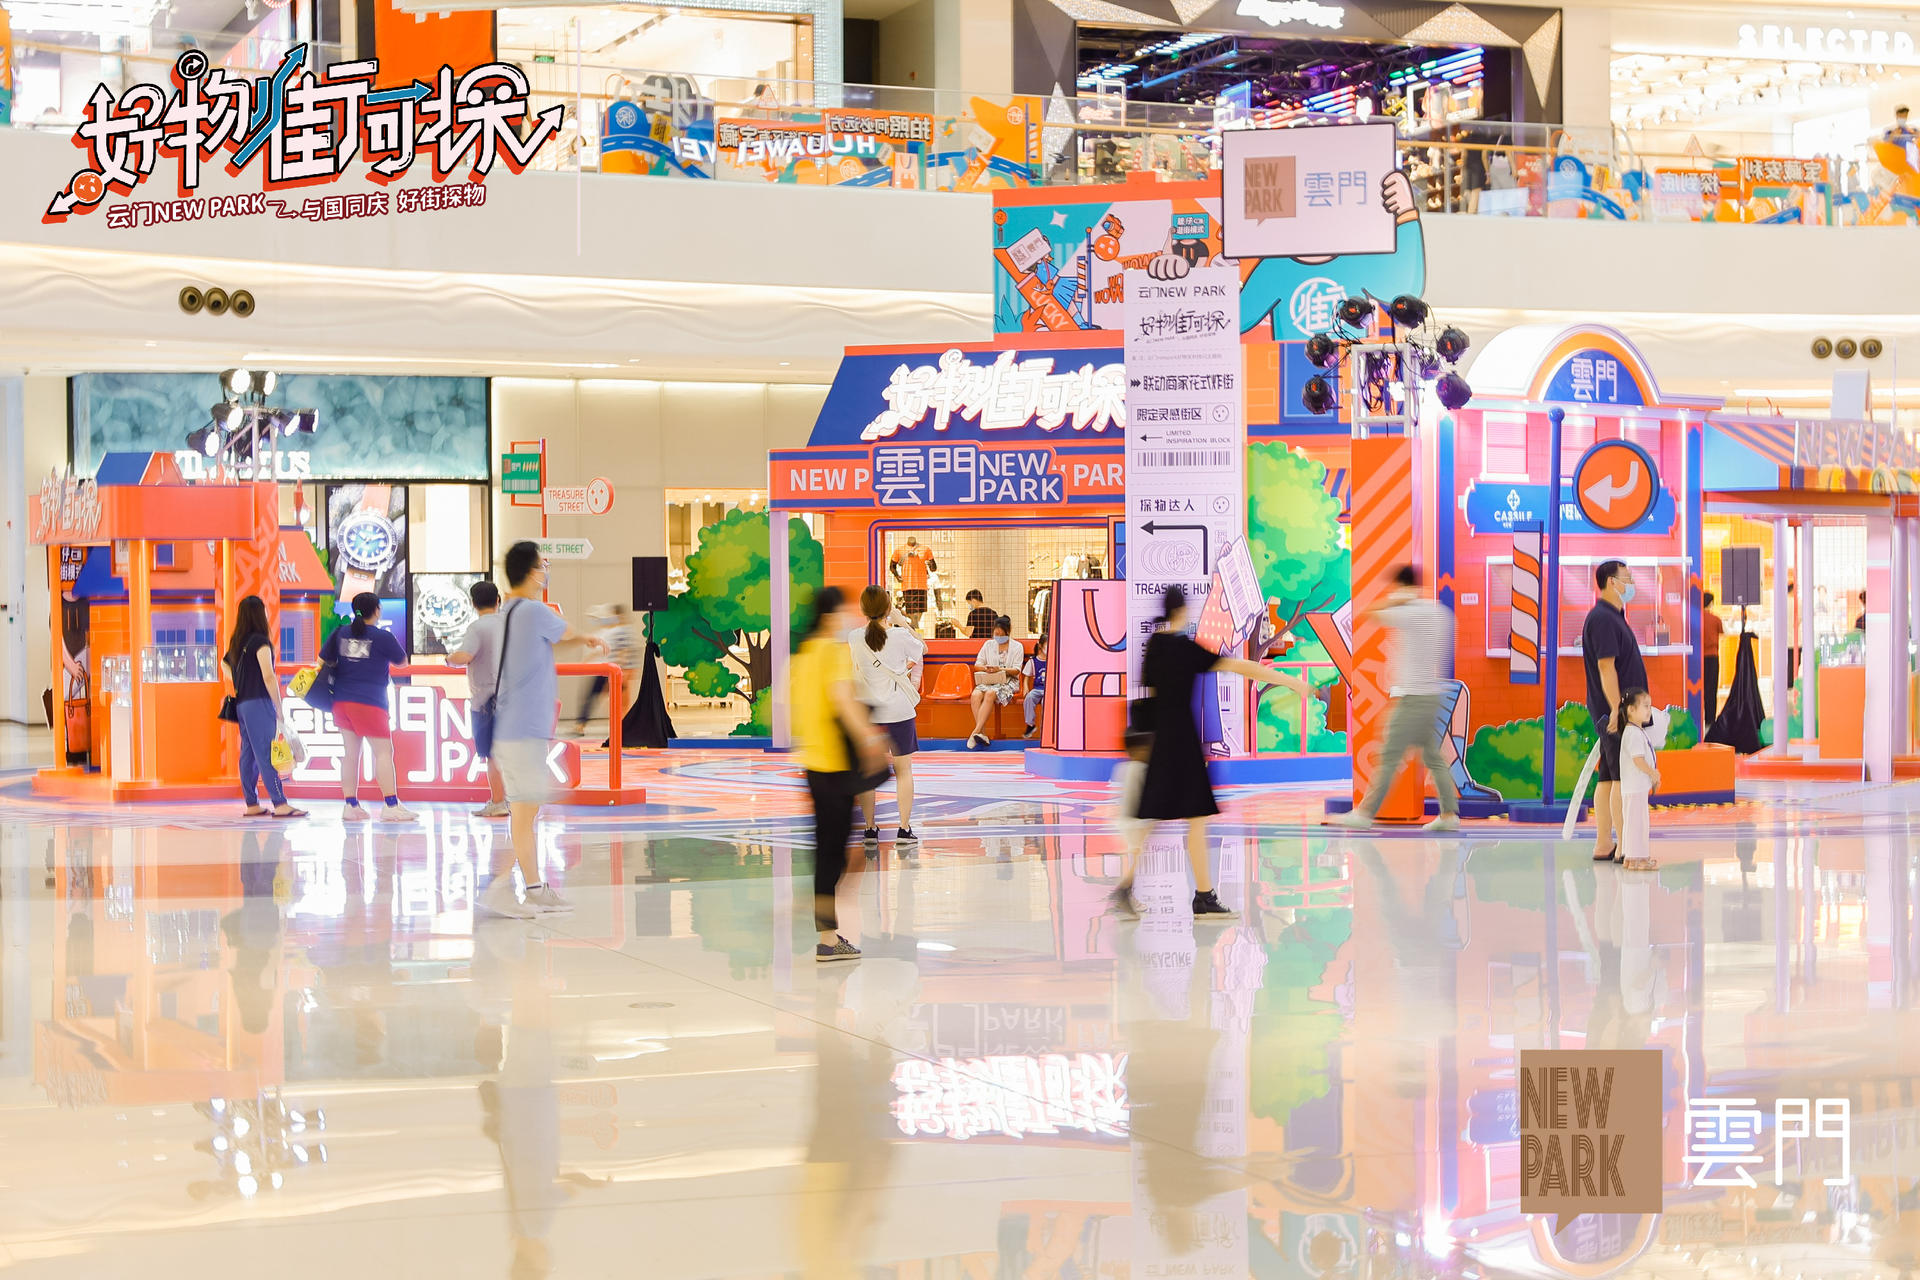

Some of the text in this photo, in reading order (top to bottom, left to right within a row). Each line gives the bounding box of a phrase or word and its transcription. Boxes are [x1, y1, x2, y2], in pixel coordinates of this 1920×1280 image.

[1738, 23, 1914, 55] SELECTED
[1245, 162, 1279, 188] NEW
[1245, 188, 1283, 214] PARK
[1303, 171, 1368, 207] 雲門
[1193, 285, 1226, 297] PARK
[1571, 357, 1618, 403] 雲門
[1136, 408, 1202, 421] 限定灵感街区
[876, 447, 976, 505] 雲門
[979, 452, 1049, 477] NEW
[1073, 464, 1125, 487] PAR
[790, 468, 847, 492] NEW
[979, 478, 1060, 502] PARK
[548, 489, 584, 500] TREASURE
[1140, 498, 1195, 512] 探物达人
[559, 502, 584, 512] STREET
[556, 544, 584, 554] STREET
